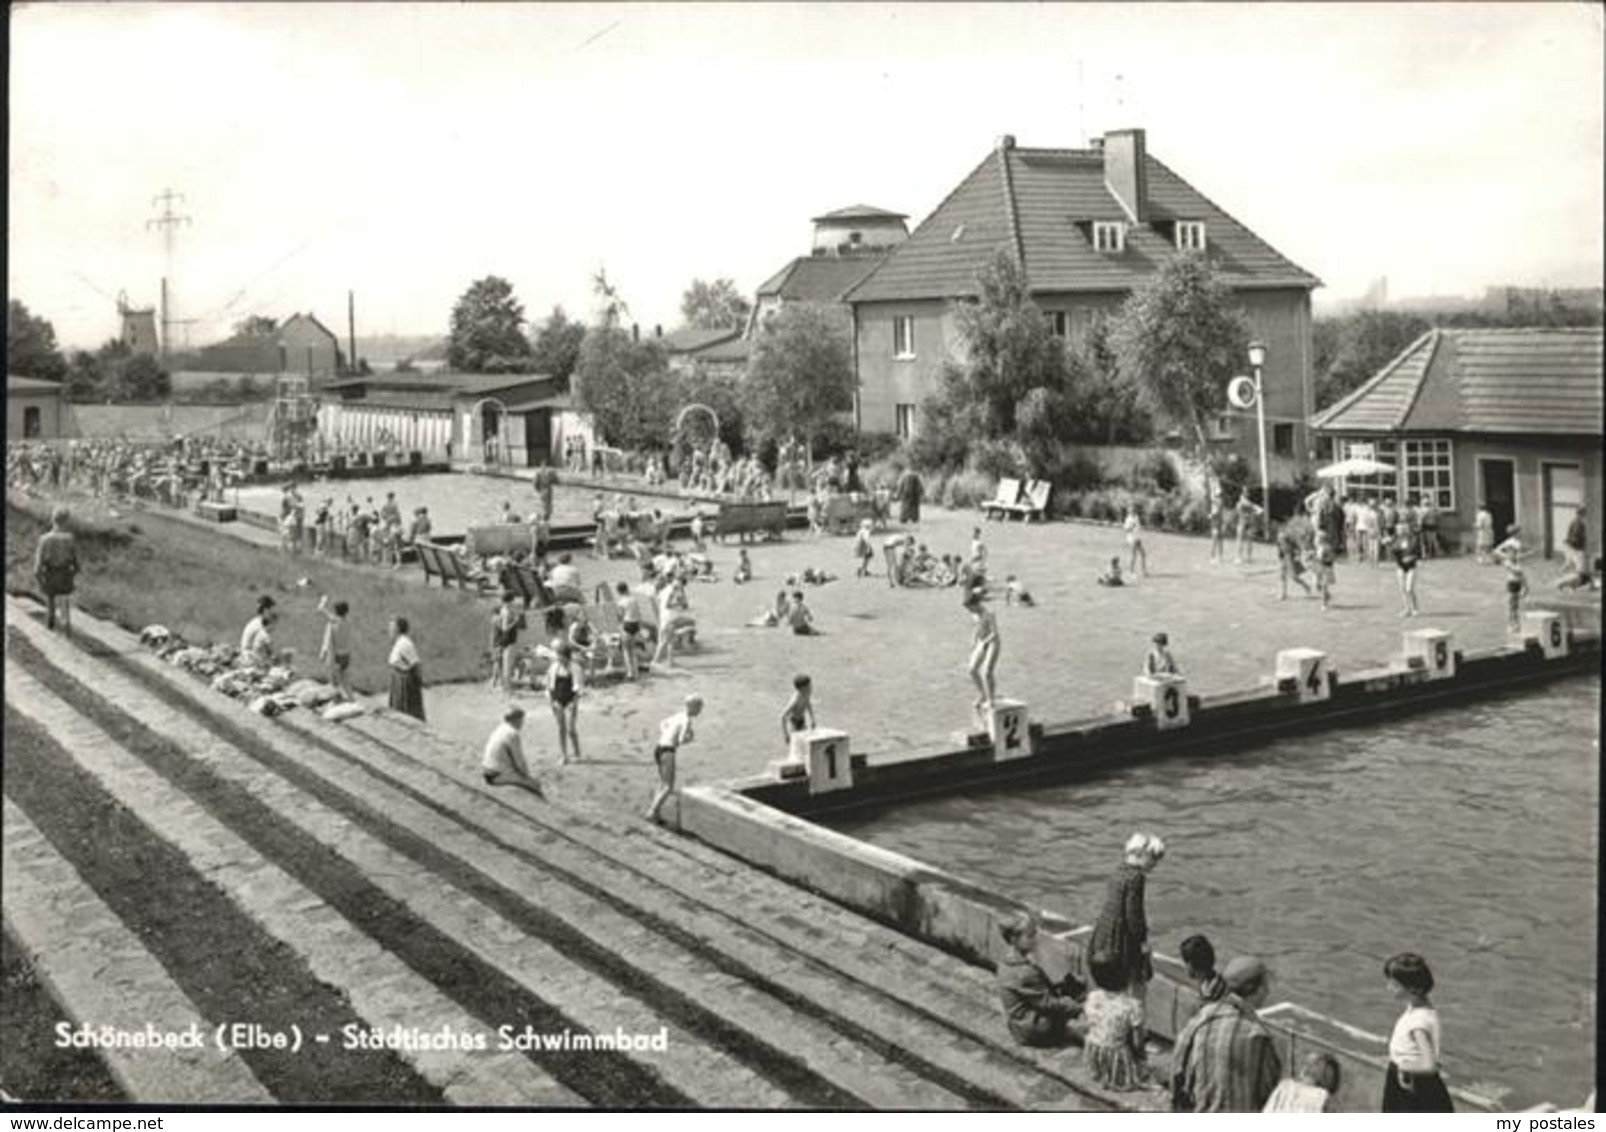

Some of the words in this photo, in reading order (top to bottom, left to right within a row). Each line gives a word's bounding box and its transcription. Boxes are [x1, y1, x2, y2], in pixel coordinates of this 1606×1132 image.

[1551, 622, 1561, 646] 6
[1307, 660, 1321, 693] 4
[1165, 688, 1178, 719] 3
[1004, 716, 1020, 749] 2
[824, 744, 836, 778] 1
